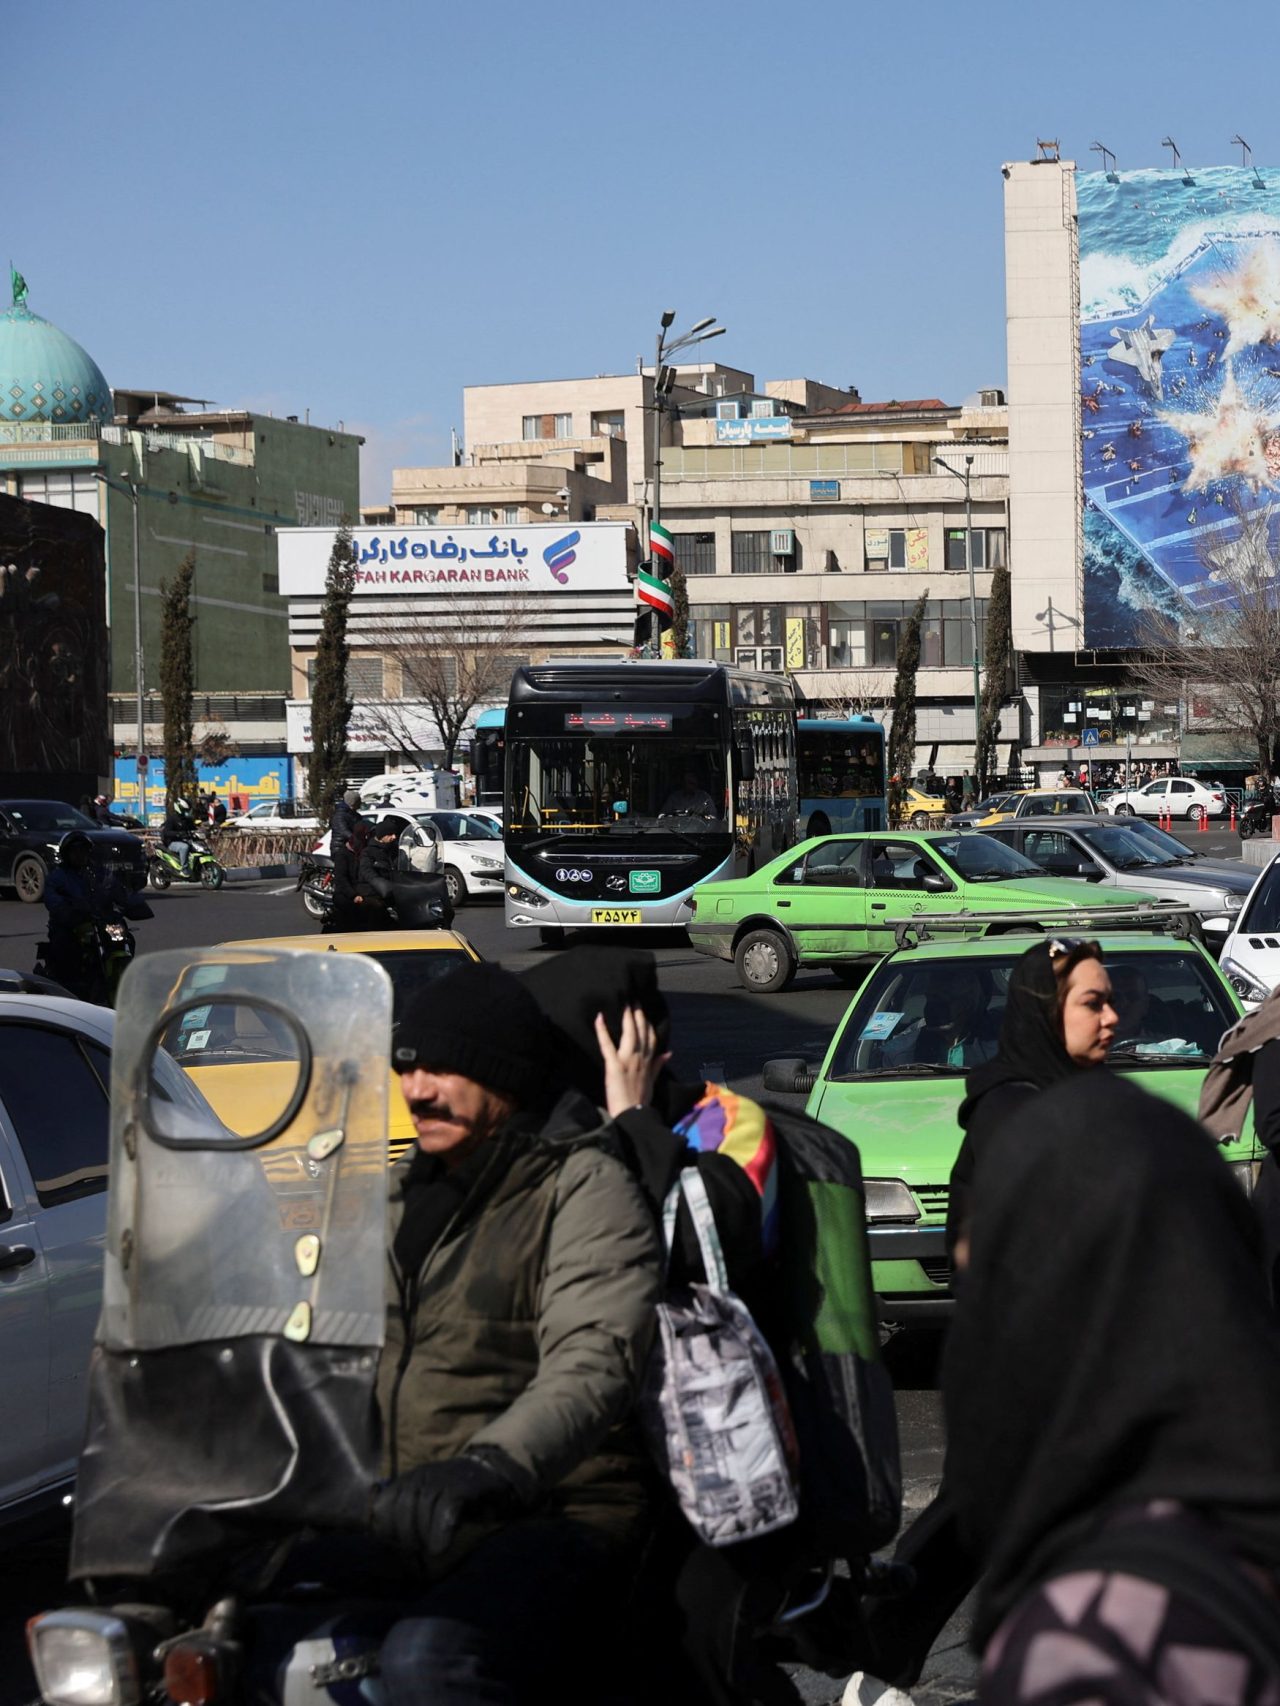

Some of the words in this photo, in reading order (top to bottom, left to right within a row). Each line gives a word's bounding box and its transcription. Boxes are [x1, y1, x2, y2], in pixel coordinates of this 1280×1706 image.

[352, 537, 409, 565] کارگرا
[411, 535, 467, 563] رفاه
[470, 535, 528, 564] بانک
[390, 568, 482, 584] KARGARAN
[484, 568, 530, 583] BANK
[595, 910, 638, 923] ۳۵۵۷۴
